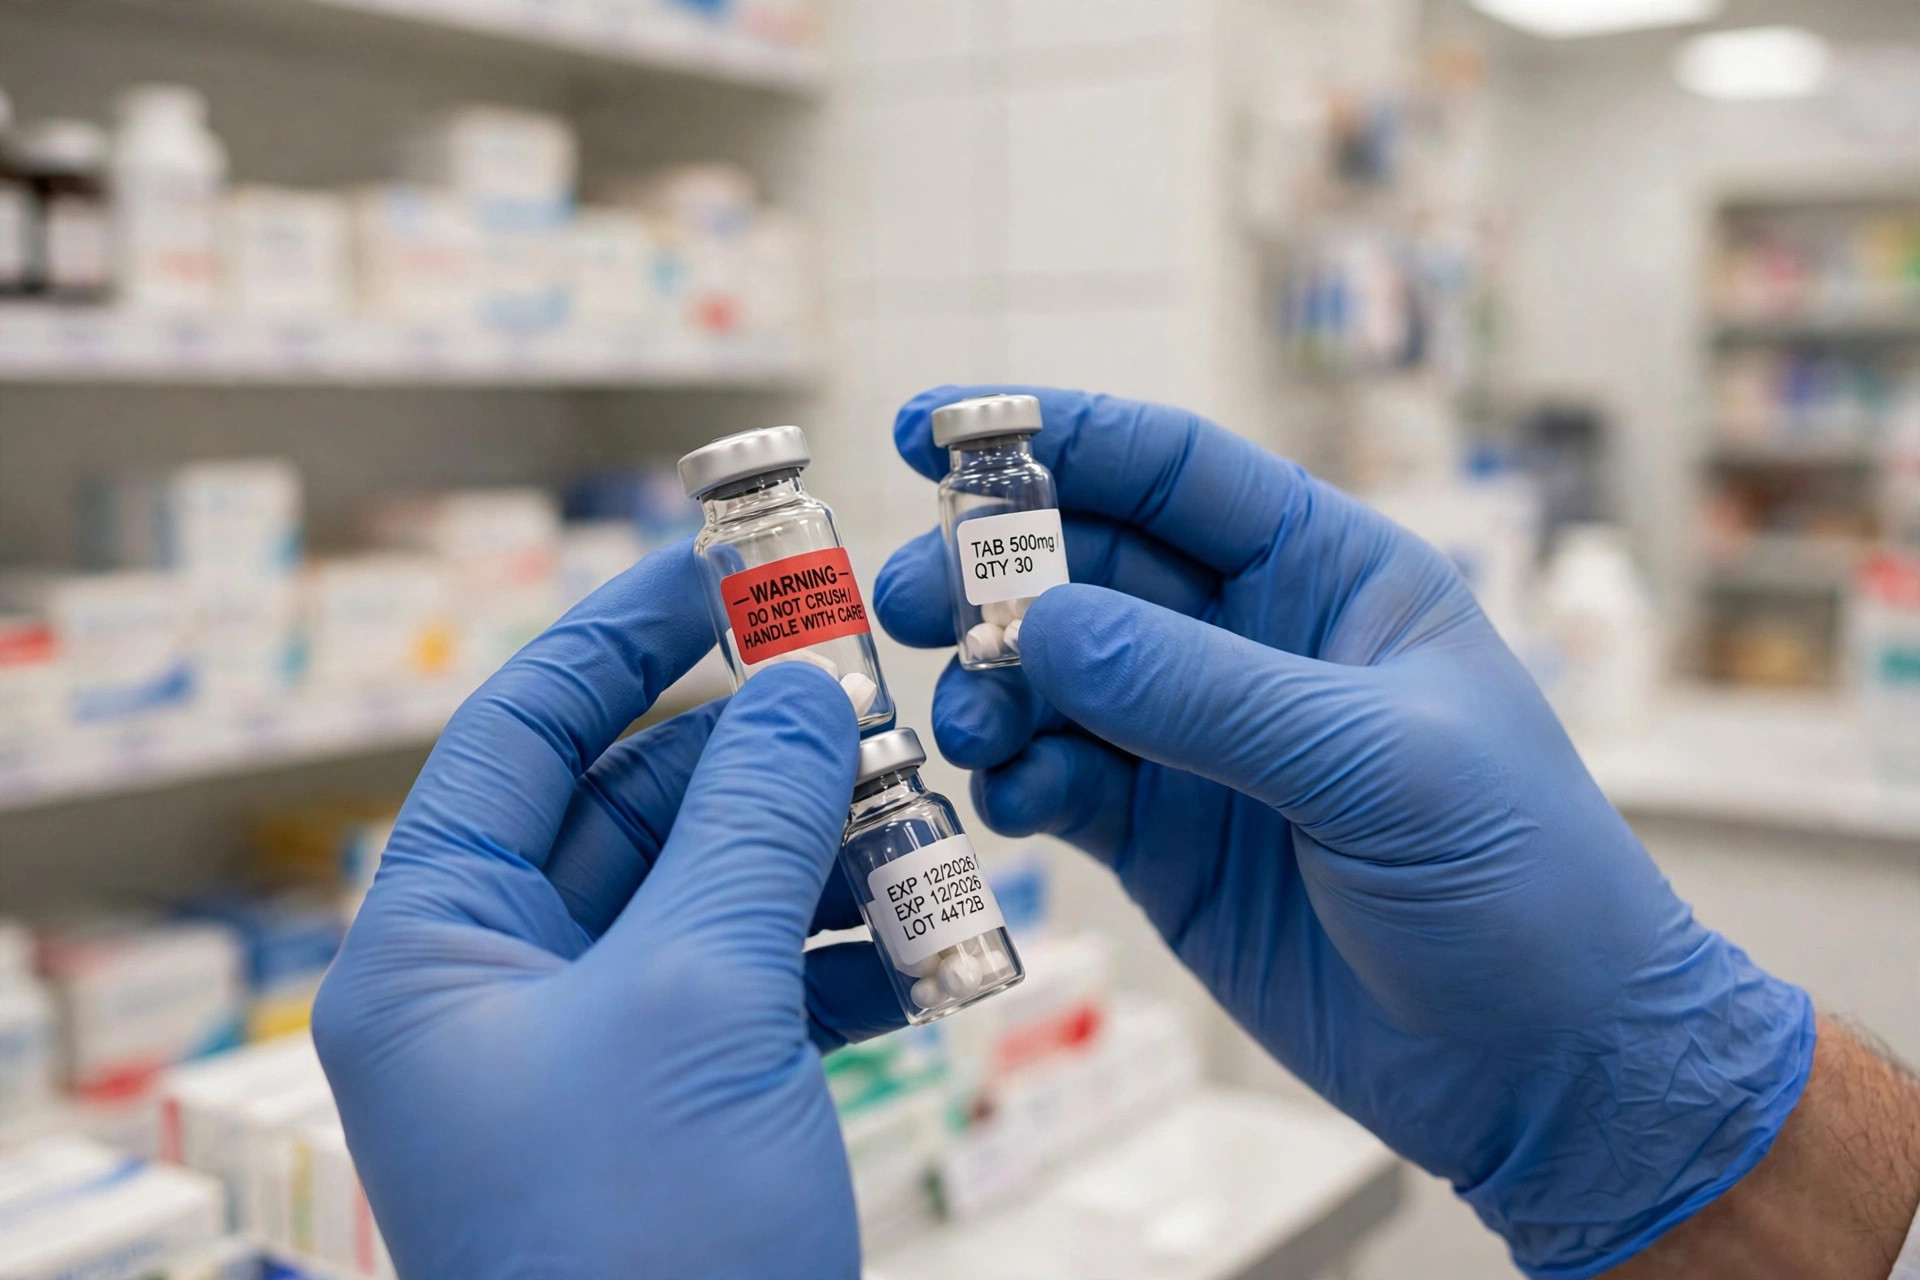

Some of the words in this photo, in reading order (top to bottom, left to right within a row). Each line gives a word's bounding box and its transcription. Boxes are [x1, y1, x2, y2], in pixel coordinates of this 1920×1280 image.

[971, 539, 1004, 558] TAB
[1009, 534, 1055, 552] 500mg
[975, 558, 1009, 579] QTY
[1014, 556, 1033, 573] 30
[743, 619, 799, 649] HANDLE
[800, 611, 836, 631] WITH
[838, 604, 864, 622] CARE
[747, 608, 769, 627] DO
[771, 597, 801, 616] NOT
[886, 877, 918, 902] EXP
[923, 856, 975, 886] 12/2026
[894, 896, 925, 922] EXP
[930, 875, 982, 905] 12/2026
[903, 913, 935, 941] LOT
[941, 895, 985, 923] 4472B
